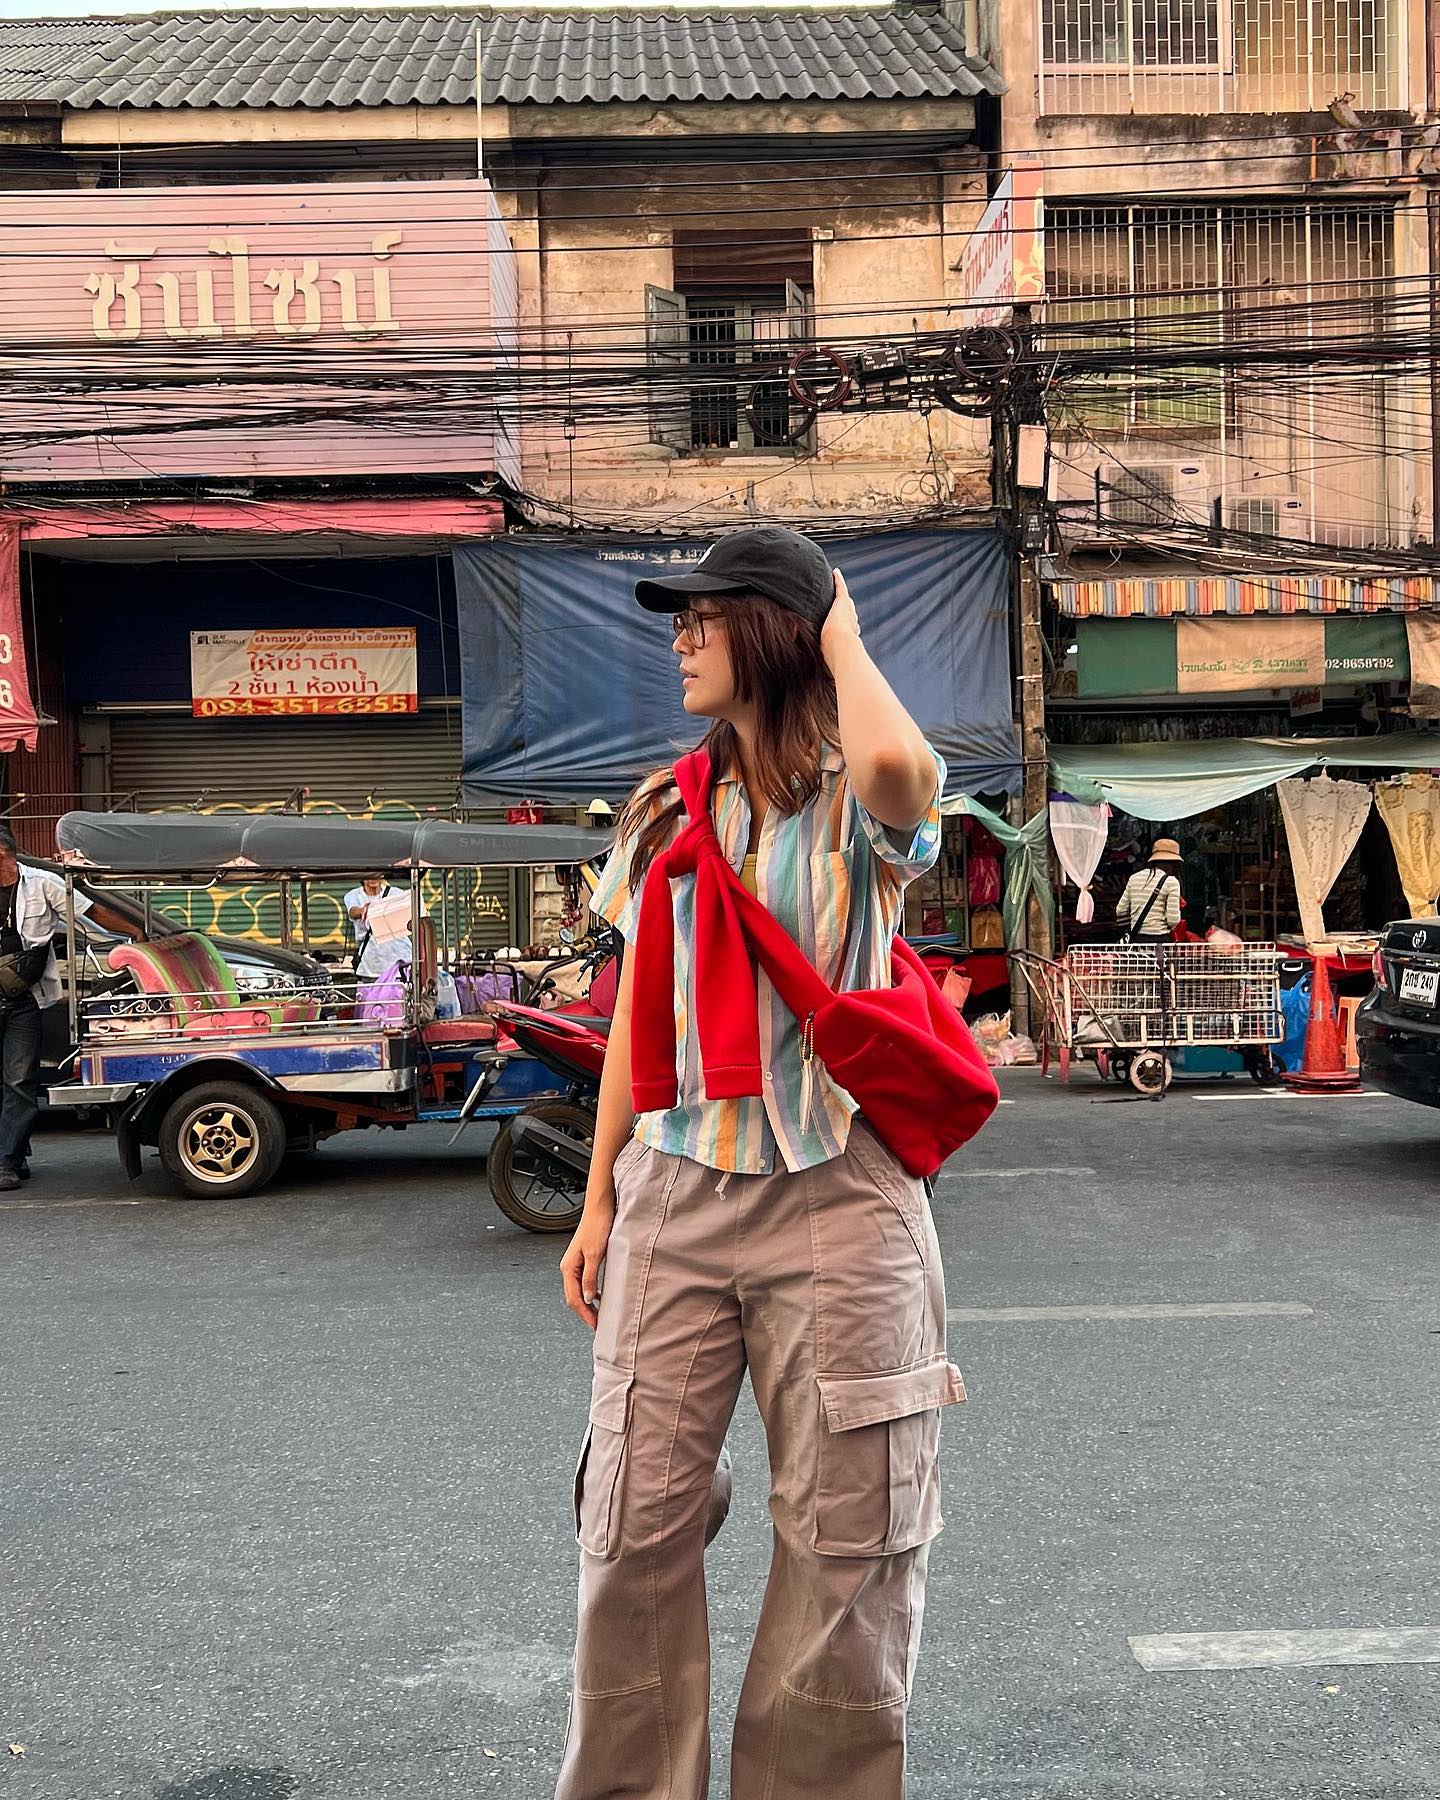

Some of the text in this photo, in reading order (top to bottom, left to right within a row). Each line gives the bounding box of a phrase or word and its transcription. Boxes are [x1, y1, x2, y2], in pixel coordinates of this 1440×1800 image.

[247, 651, 358, 672] ให้เช่าตึก
[228, 670, 379, 696] 2 ชั้น 1 ห้องน้ำ
